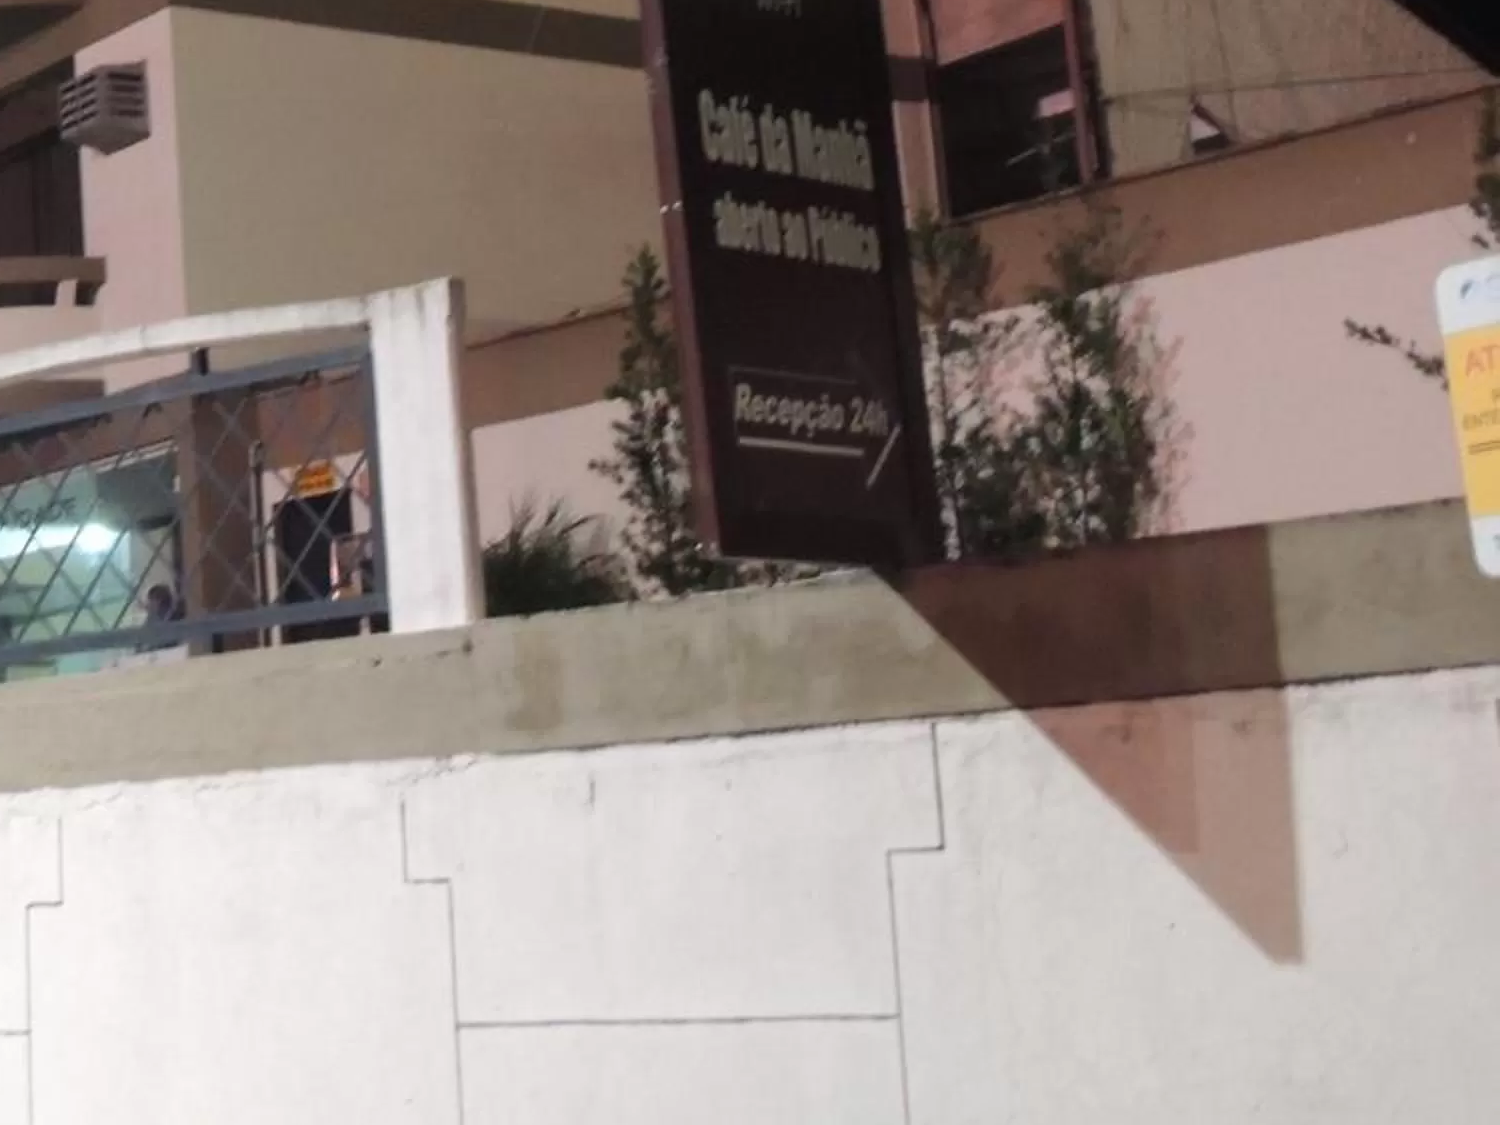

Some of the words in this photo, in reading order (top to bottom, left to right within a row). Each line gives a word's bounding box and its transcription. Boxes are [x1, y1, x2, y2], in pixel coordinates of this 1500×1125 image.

[698, 88, 759, 171] Café
[759, 103, 793, 176] da
[713, 190, 782, 256] aberto
[781, 210, 809, 262] ao
[807, 205, 882, 275] Público
[735, 382, 846, 439] Recepção
[849, 395, 889, 436] 24h
